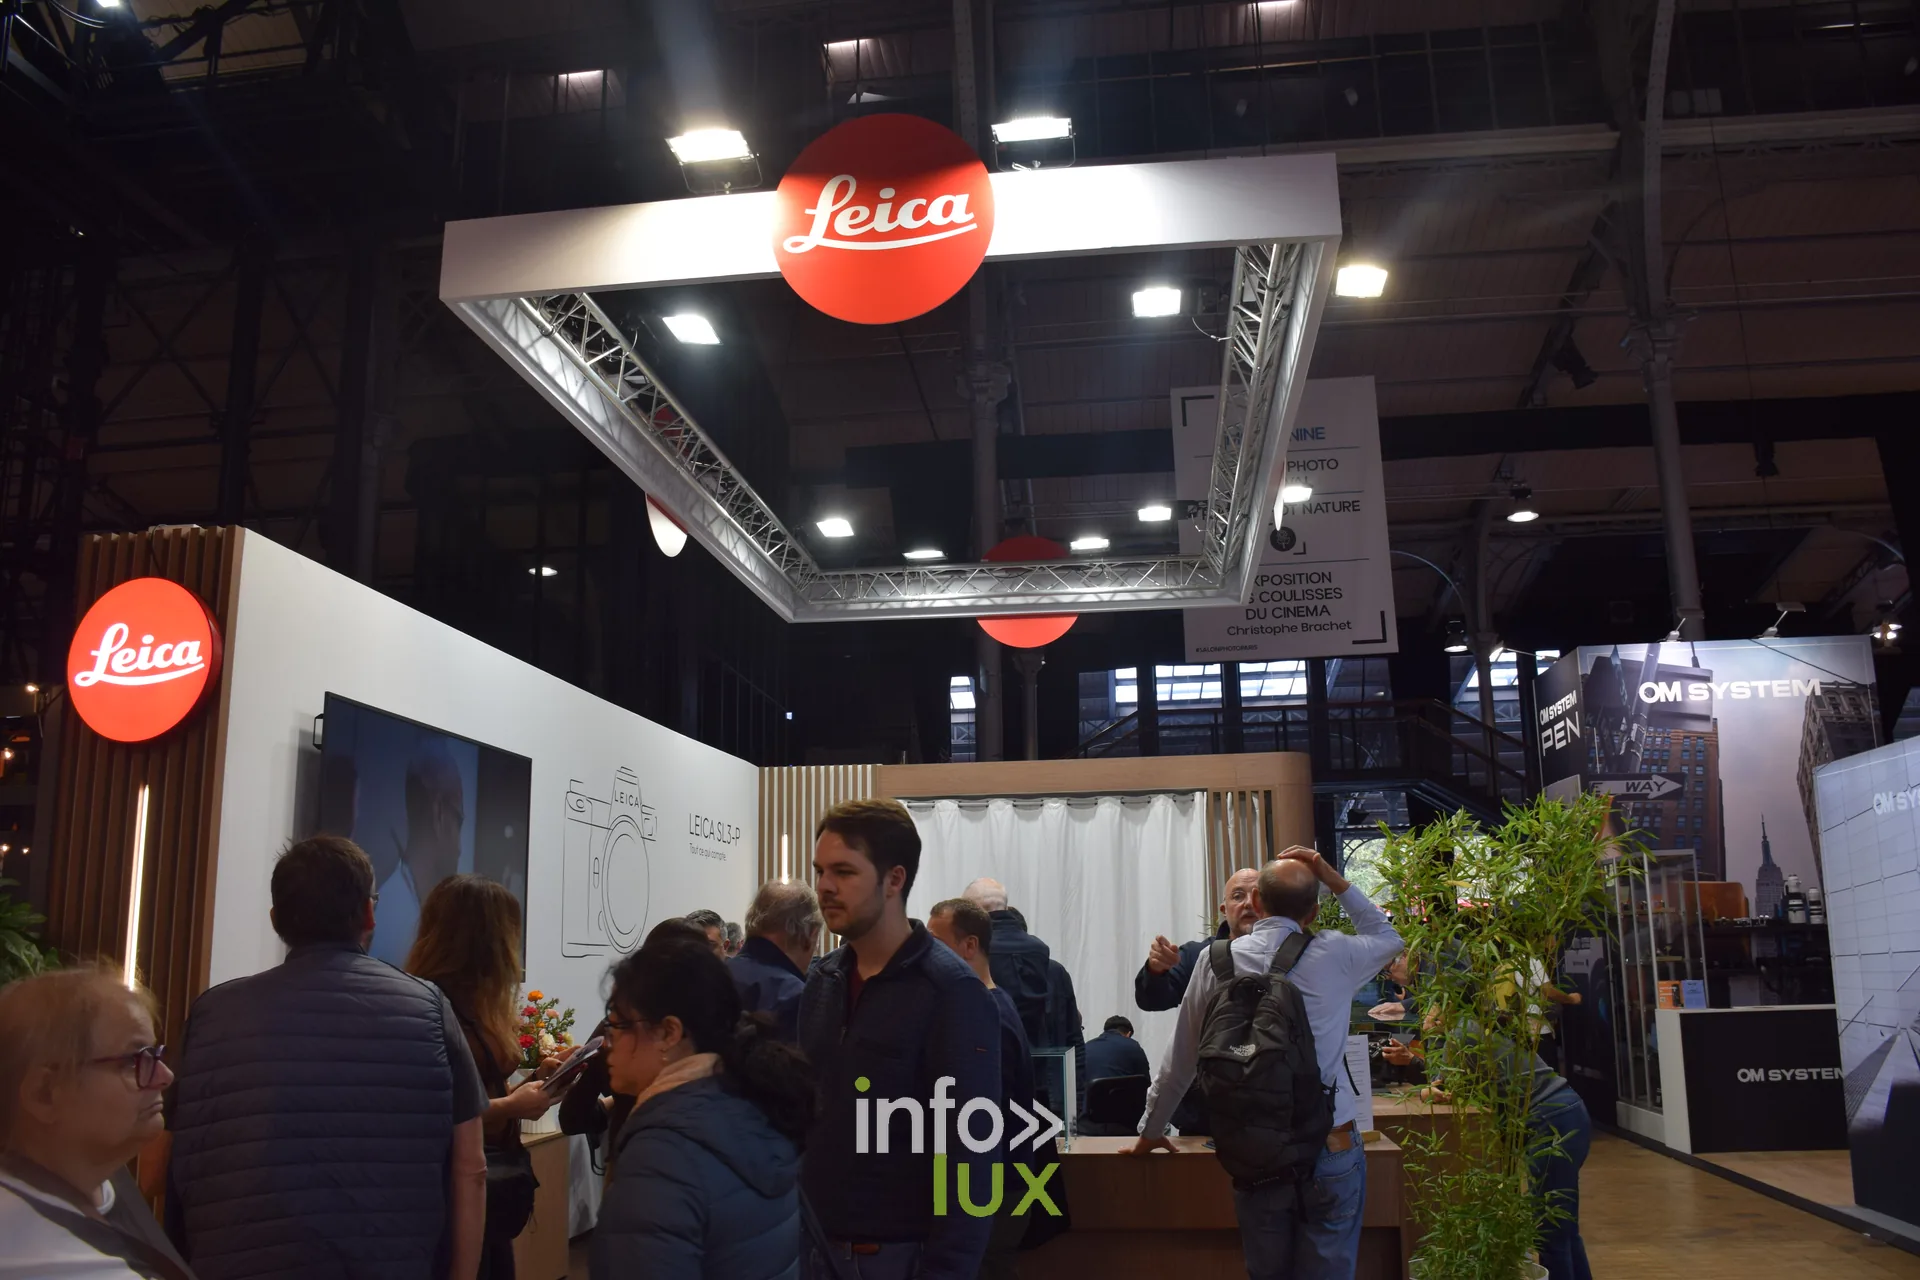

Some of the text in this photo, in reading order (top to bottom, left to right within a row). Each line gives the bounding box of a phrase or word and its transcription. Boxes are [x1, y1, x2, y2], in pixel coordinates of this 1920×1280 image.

[783, 174, 977, 253] Leica
[1287, 458, 1339, 472] PHOTO
[1302, 500, 1361, 514] NATURE
[1259, 587, 1343, 603] COULISSES
[1245, 605, 1331, 620] DU CINEMA
[1227, 620, 1352, 636] Christophe Brachet
[75, 623, 204, 687] Leica
[1639, 678, 1821, 703] OM SYSTEM
[1540, 690, 1577, 726] OM SYSTEM
[1541, 711, 1581, 756] PEN
[1625, 780, 1668, 793] WAY
[614, 790, 640, 808] LEICA
[1873, 791, 1895, 815] OM
[689, 813, 741, 847] LEICA SL3-P
[1737, 1068, 1765, 1083] OM
